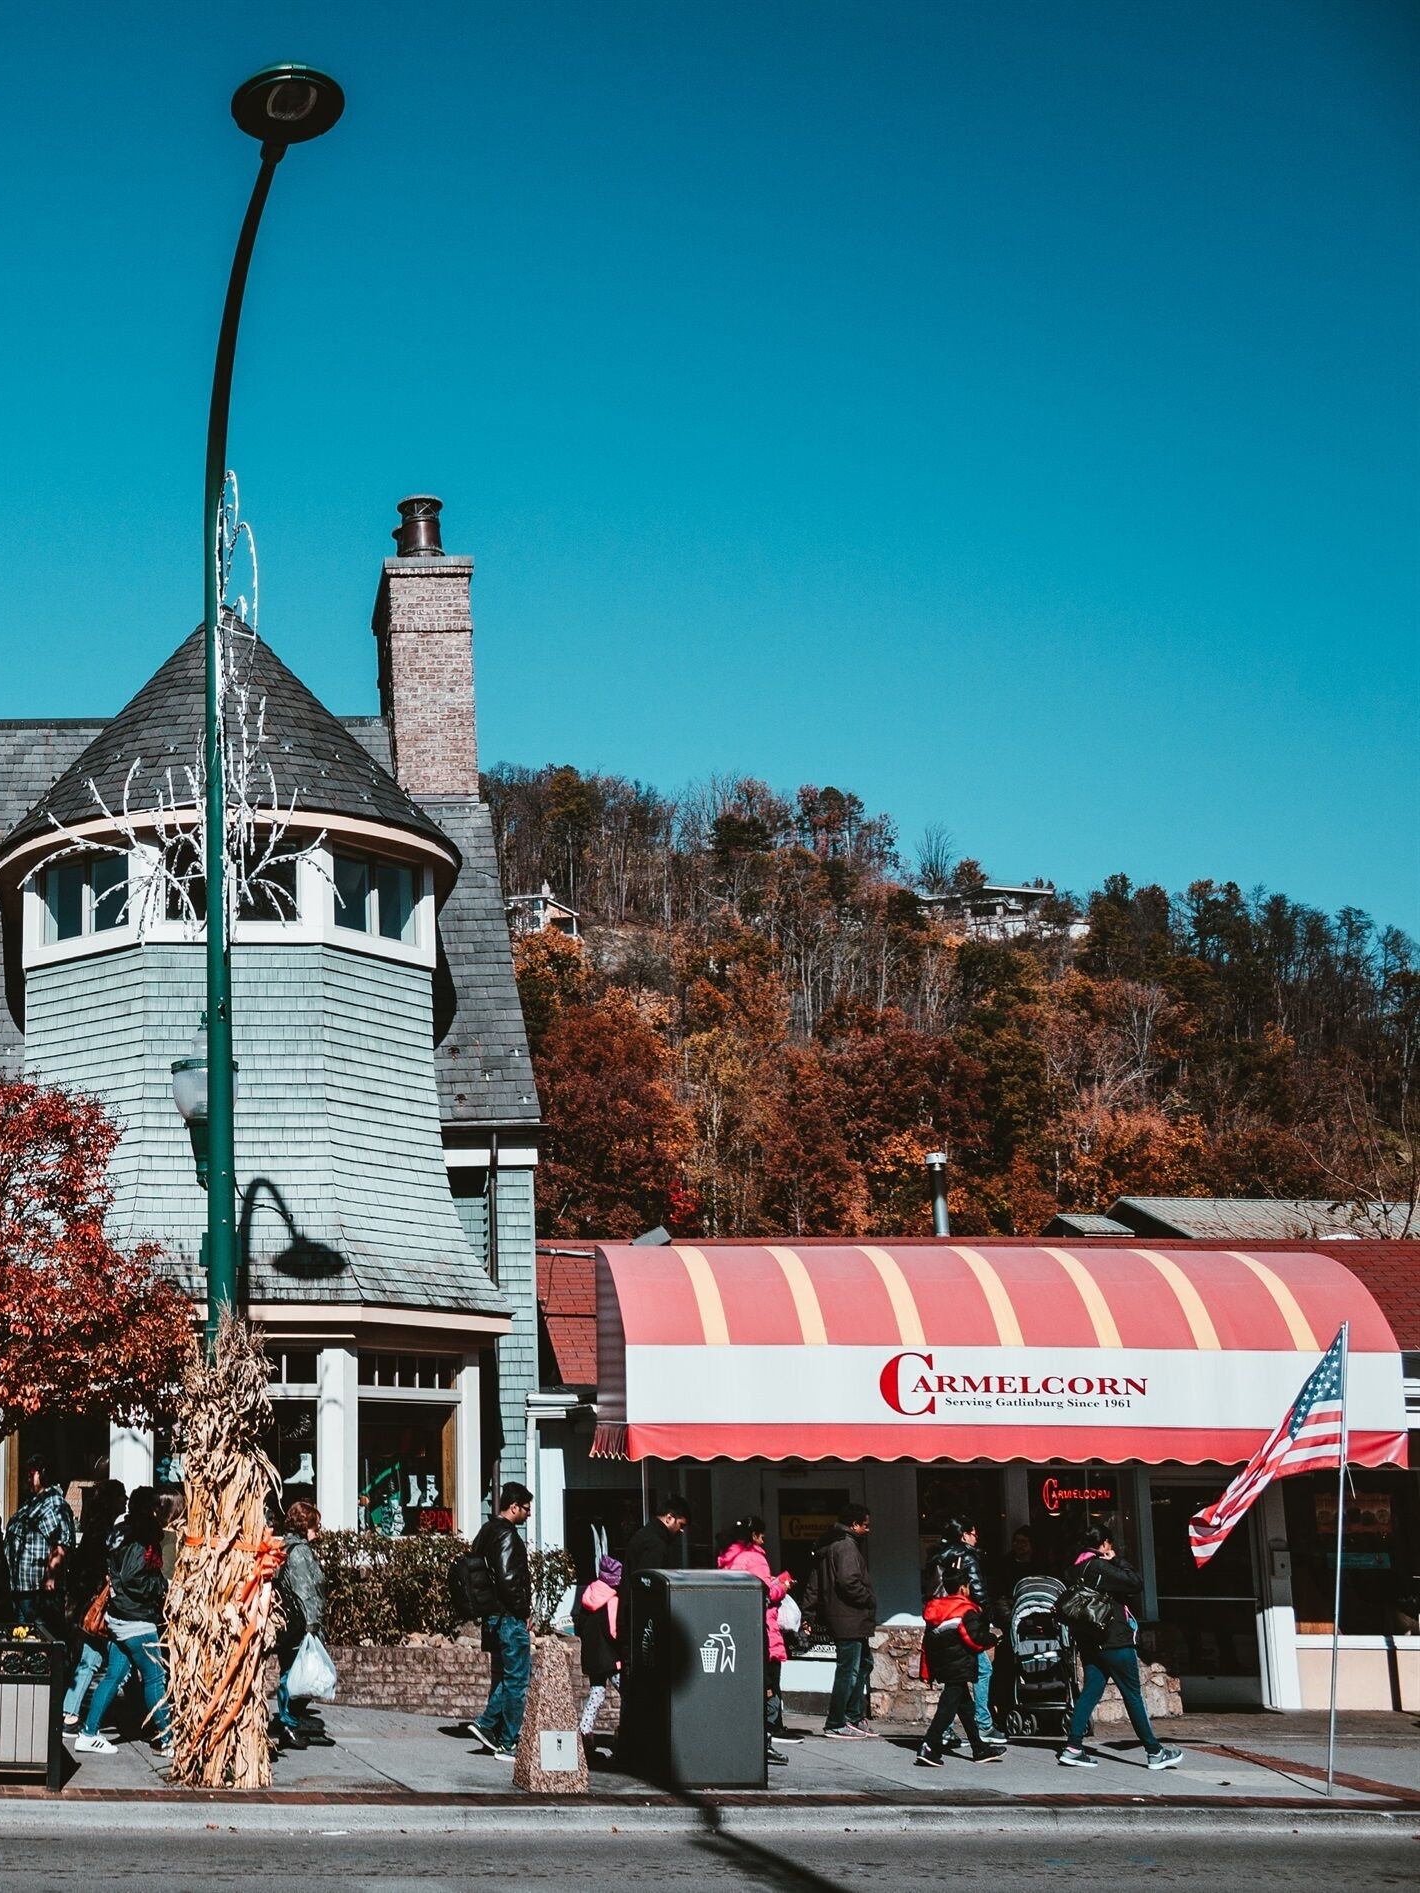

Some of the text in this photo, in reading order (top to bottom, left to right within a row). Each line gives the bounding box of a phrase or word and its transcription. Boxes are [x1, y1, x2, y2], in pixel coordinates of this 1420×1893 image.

[879, 1352, 1148, 1416] CARMELCORN
[945, 1397, 1132, 1410] Serving Gatlinburg Since 1961
[1042, 1478, 1111, 1511] CARMELCORN
